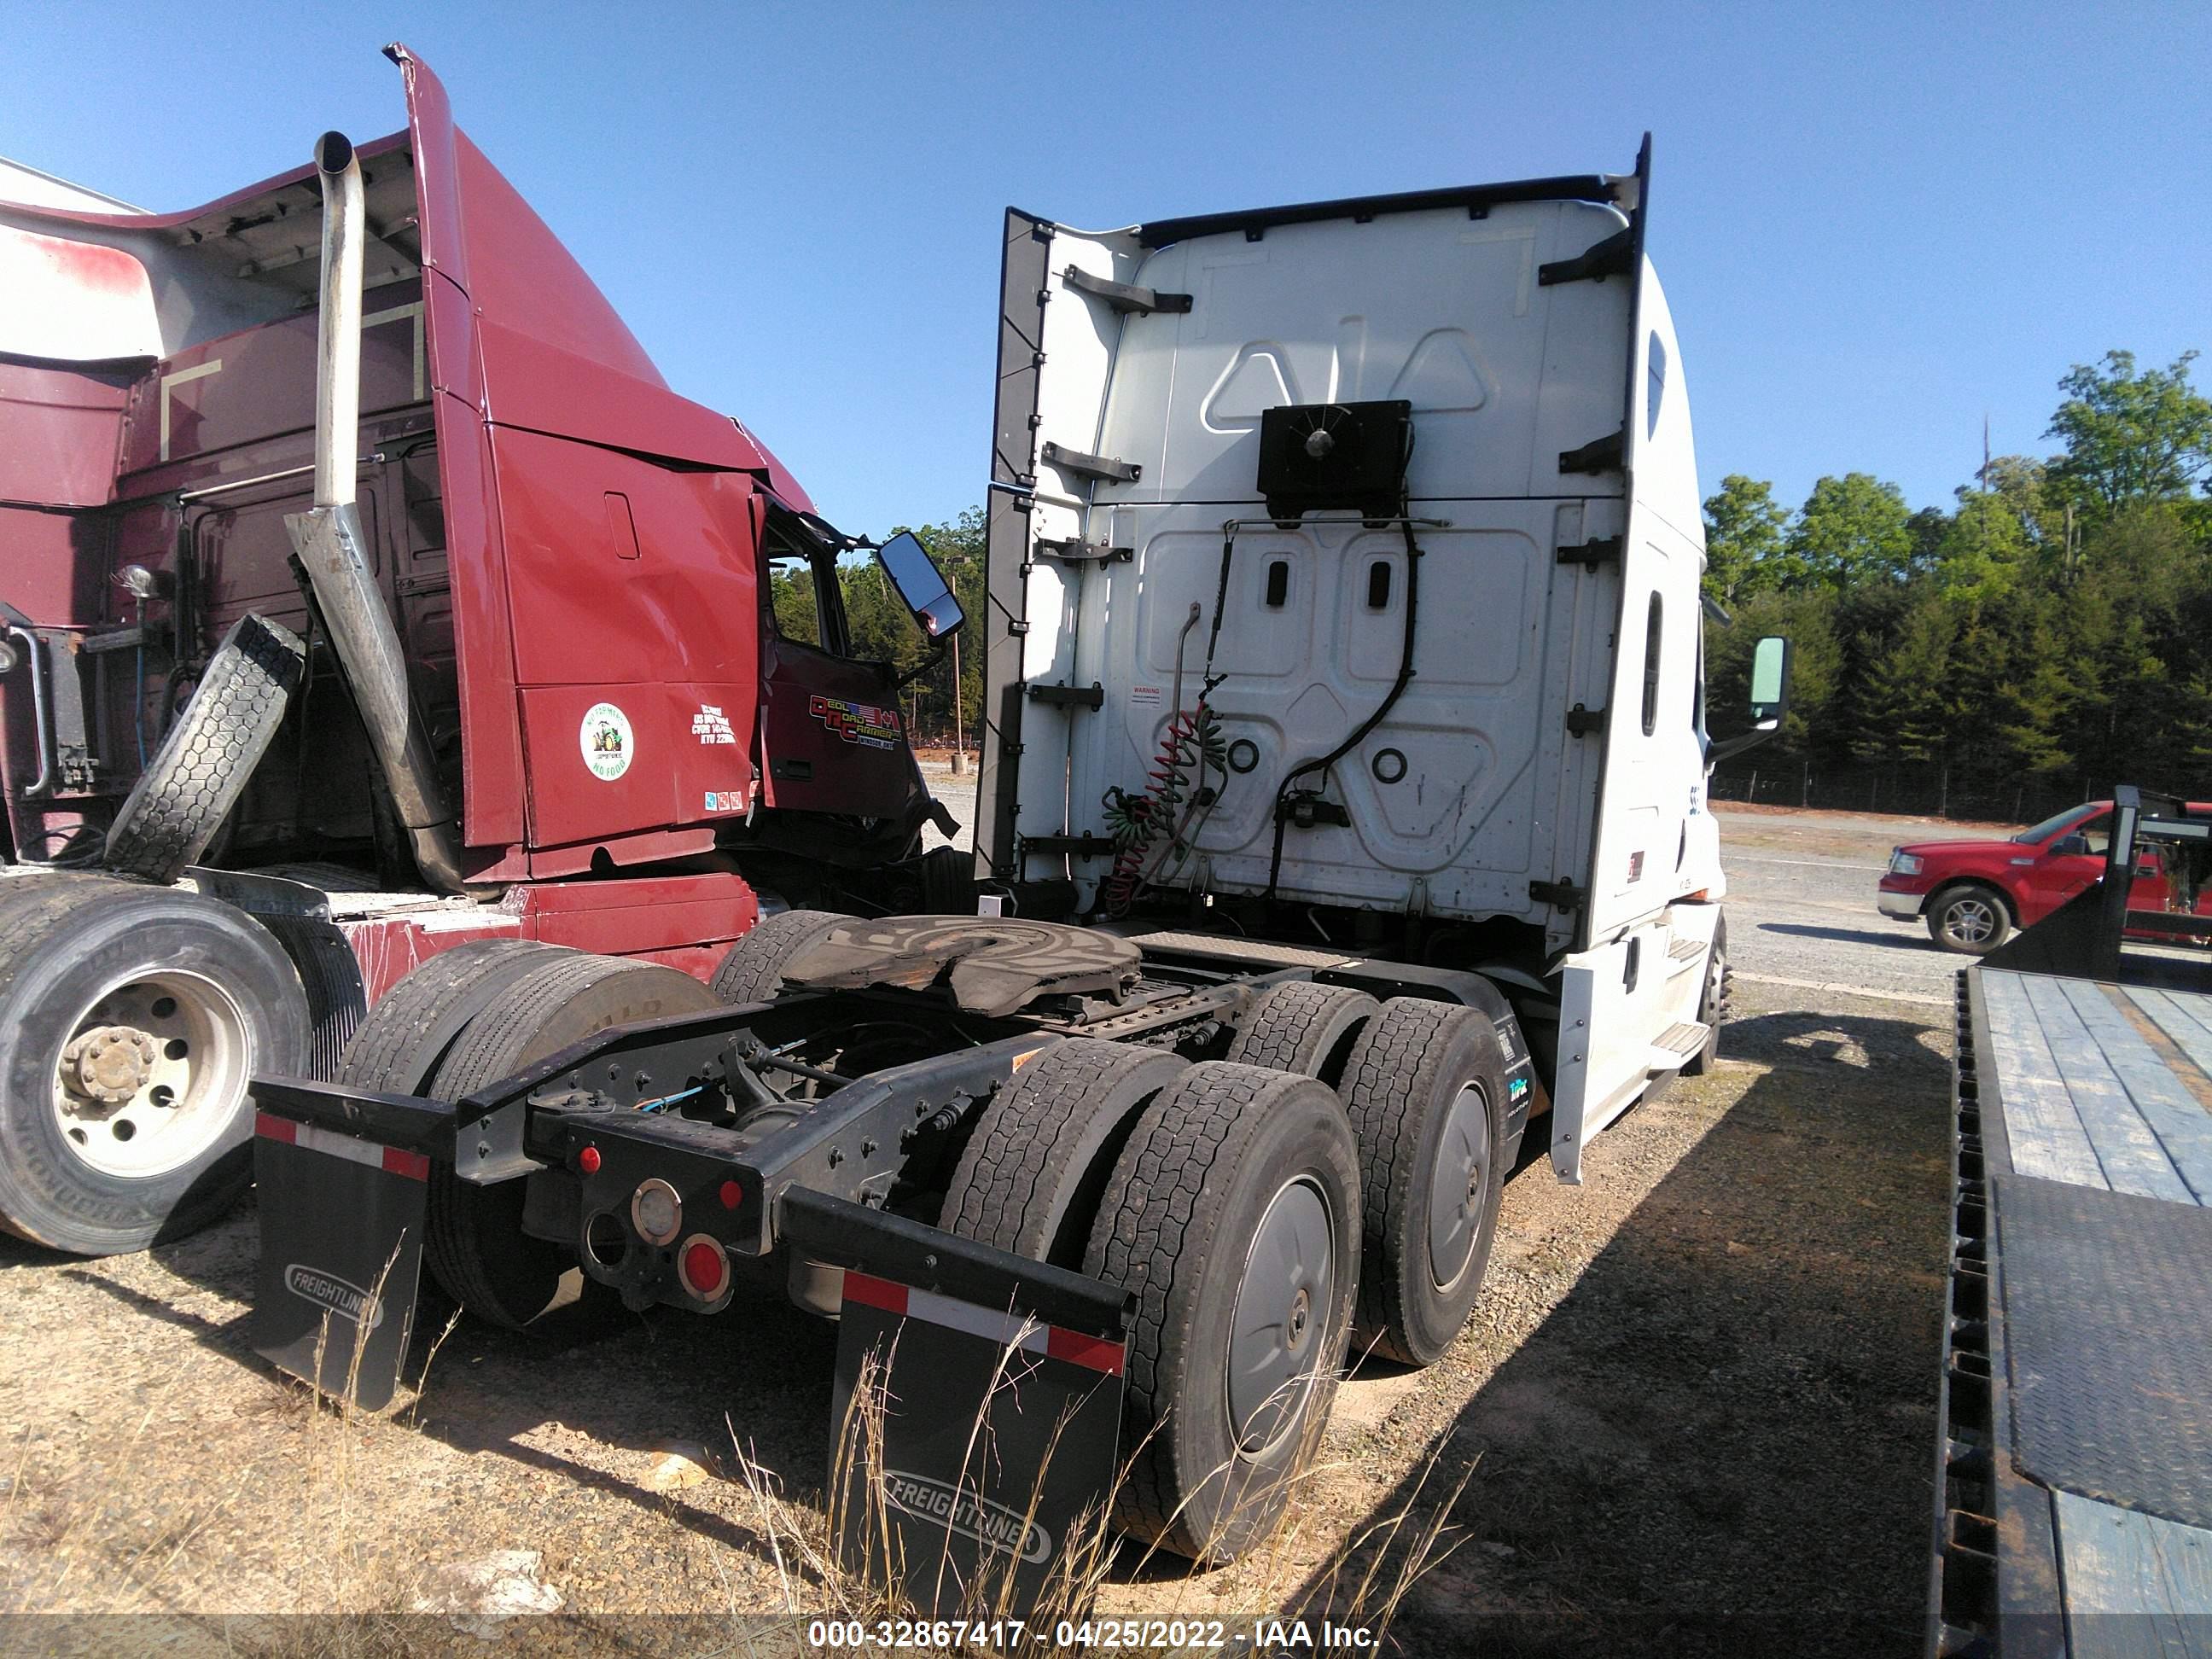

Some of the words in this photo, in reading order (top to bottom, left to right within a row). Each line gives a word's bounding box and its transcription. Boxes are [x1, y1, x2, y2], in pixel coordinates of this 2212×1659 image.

[811, 696, 848, 714] DEOL
[826, 709, 864, 726] ROAD
[606, 759, 626, 777] FOOD
[294, 1272, 371, 1318] FREIGHTLIN
[893, 1481, 1034, 1551] FREIGHTLINER
